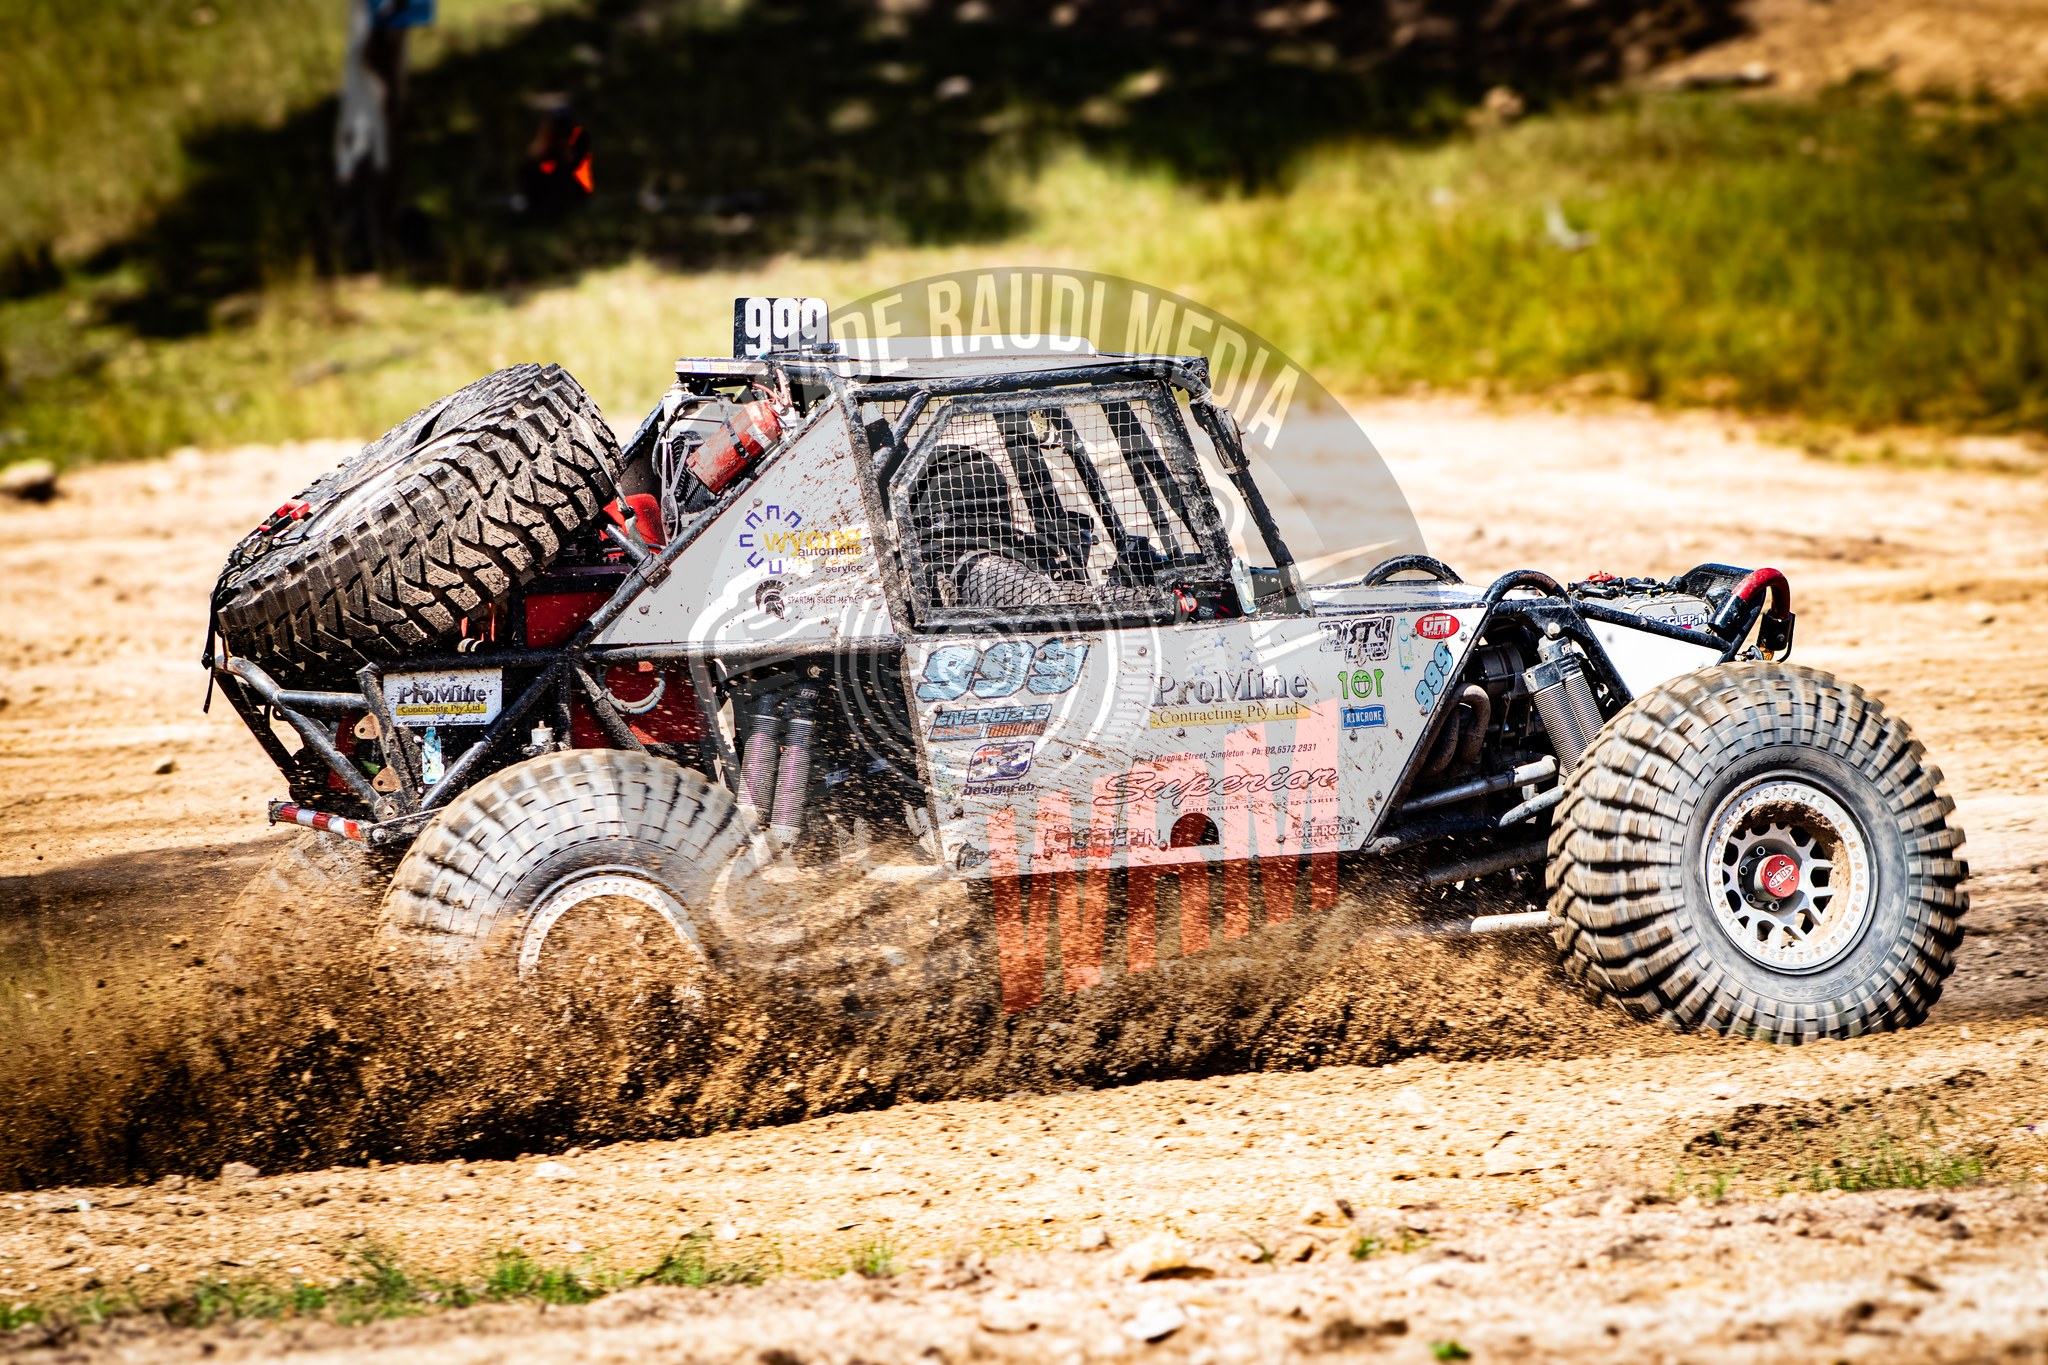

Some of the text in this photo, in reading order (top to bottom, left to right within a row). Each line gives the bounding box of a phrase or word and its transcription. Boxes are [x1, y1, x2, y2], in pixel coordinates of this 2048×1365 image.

[745, 297, 828, 356] 999
[763, 529, 862, 557] wyong
[798, 545, 862, 557] automatic
[825, 564, 863, 573] service
[915, 637, 1091, 702] 999
[1415, 641, 1453, 714] 999
[397, 684, 487, 704] ProMine
[1152, 668, 1308, 707] ProMine
[401, 703, 480, 714] Contracting Pty Ltd
[935, 705, 1052, 727] ENERGIZED
[1160, 701, 1298, 723] Contracting Pty Ltd
[1346, 710, 1382, 723] KINCROME
[1210, 749, 1244, 760] Singleton
[1277, 745, 1296, 754] 6572
[1297, 743, 1317, 753] 2931
[1093, 766, 1339, 806] Superior
[1184, 804, 1239, 813] PREMIUM
[1269, 797, 1341, 808] ACCESSORIES
[1770, 865, 1793, 887] SOLID
